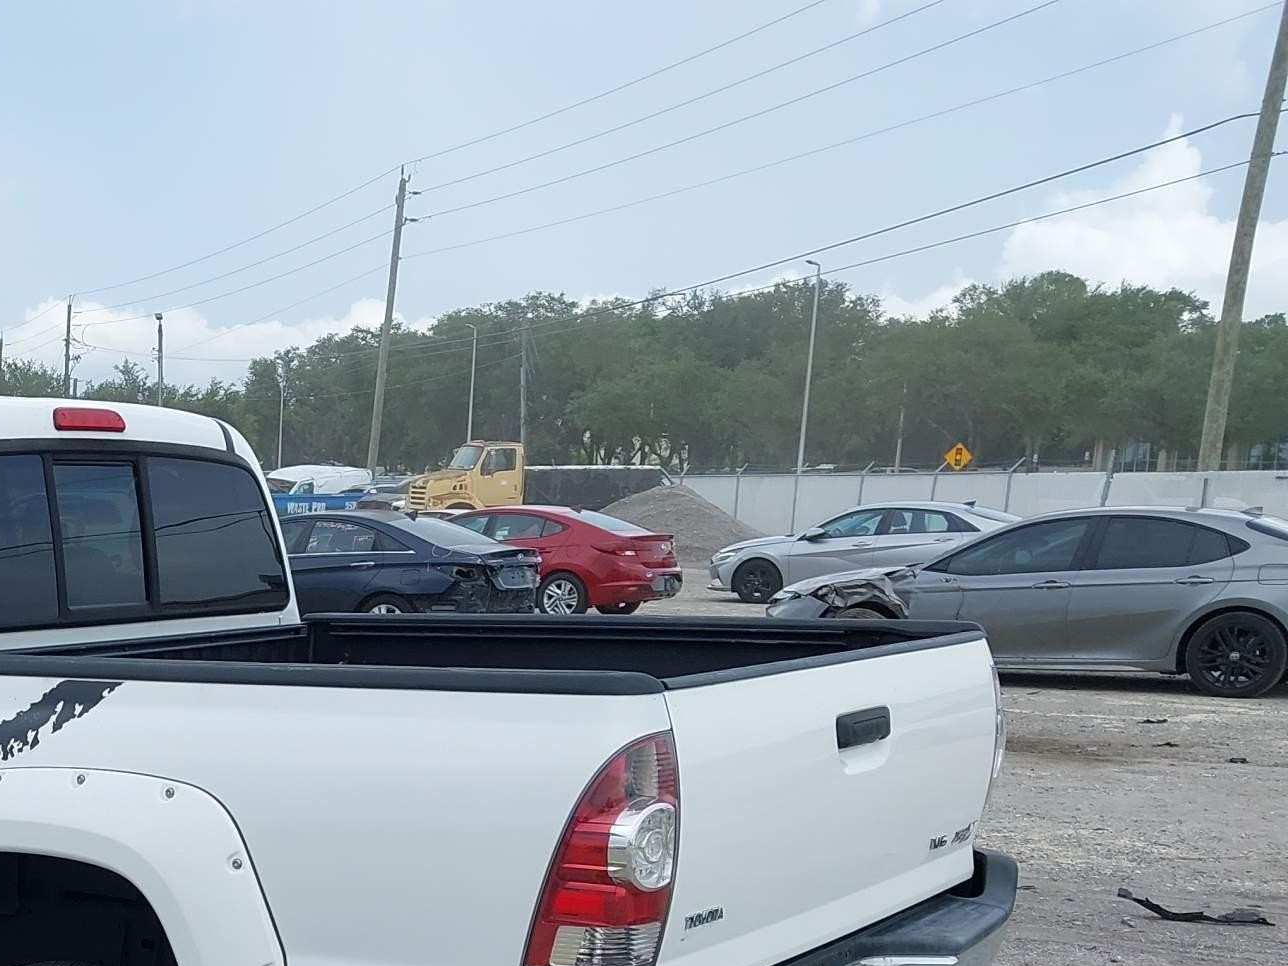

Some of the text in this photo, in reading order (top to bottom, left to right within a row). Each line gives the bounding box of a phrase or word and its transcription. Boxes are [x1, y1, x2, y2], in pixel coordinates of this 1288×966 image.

[287, 502, 310, 514] WASTE
[312, 502, 326, 513] PRO
[684, 907, 724, 930] TOYOTA
